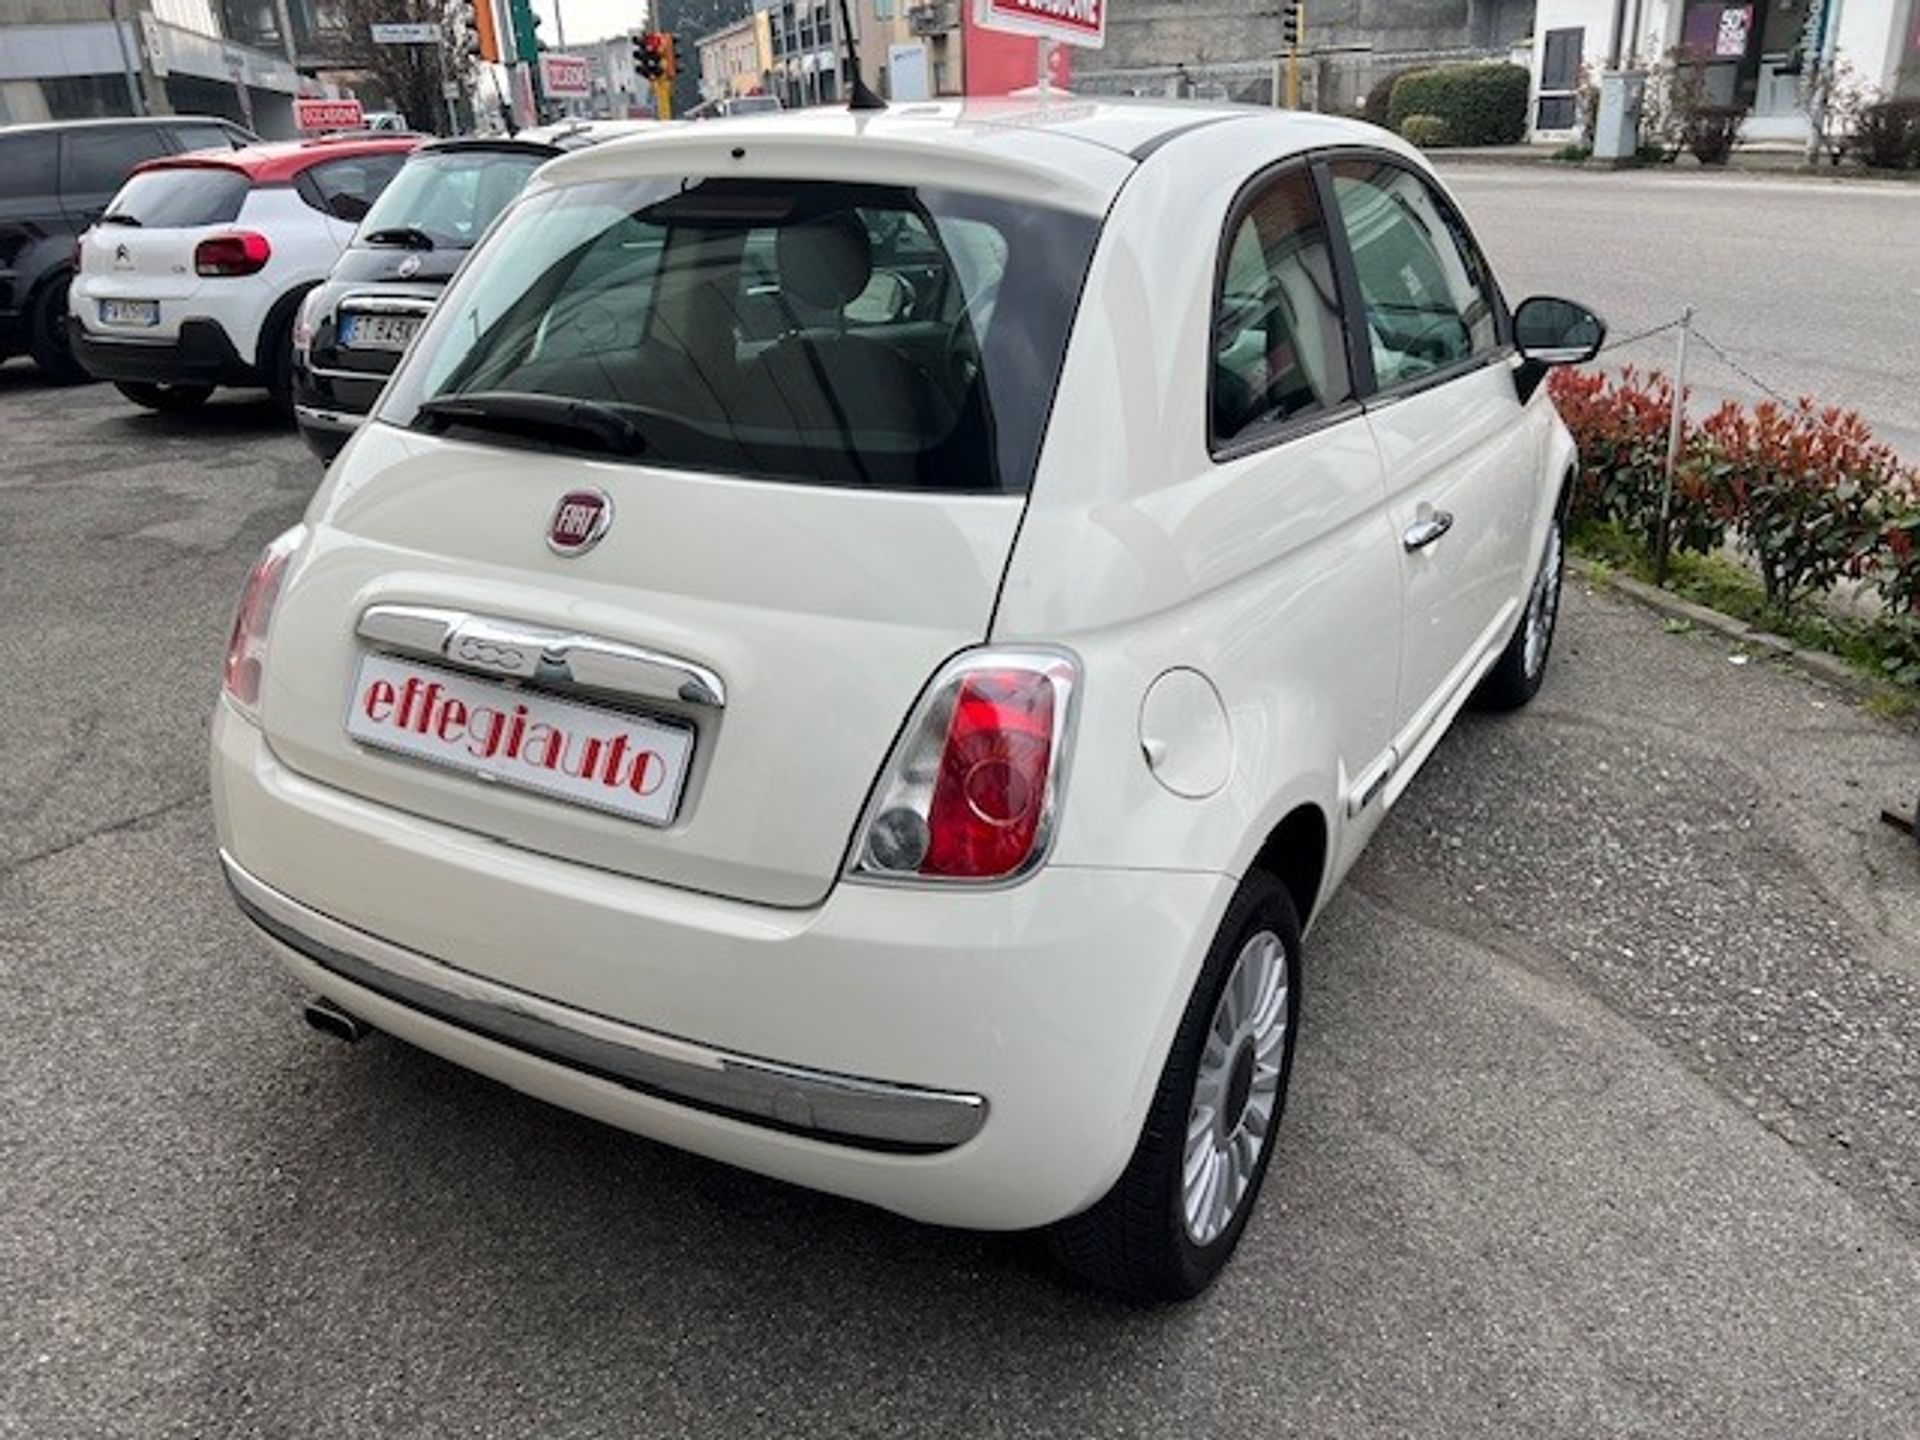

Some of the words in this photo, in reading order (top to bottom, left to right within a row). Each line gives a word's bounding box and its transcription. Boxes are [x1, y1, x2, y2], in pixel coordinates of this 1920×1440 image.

[556, 503, 599, 536] FIAT
[459, 635, 524, 670] 500
[363, 675, 668, 797] effegiauto
